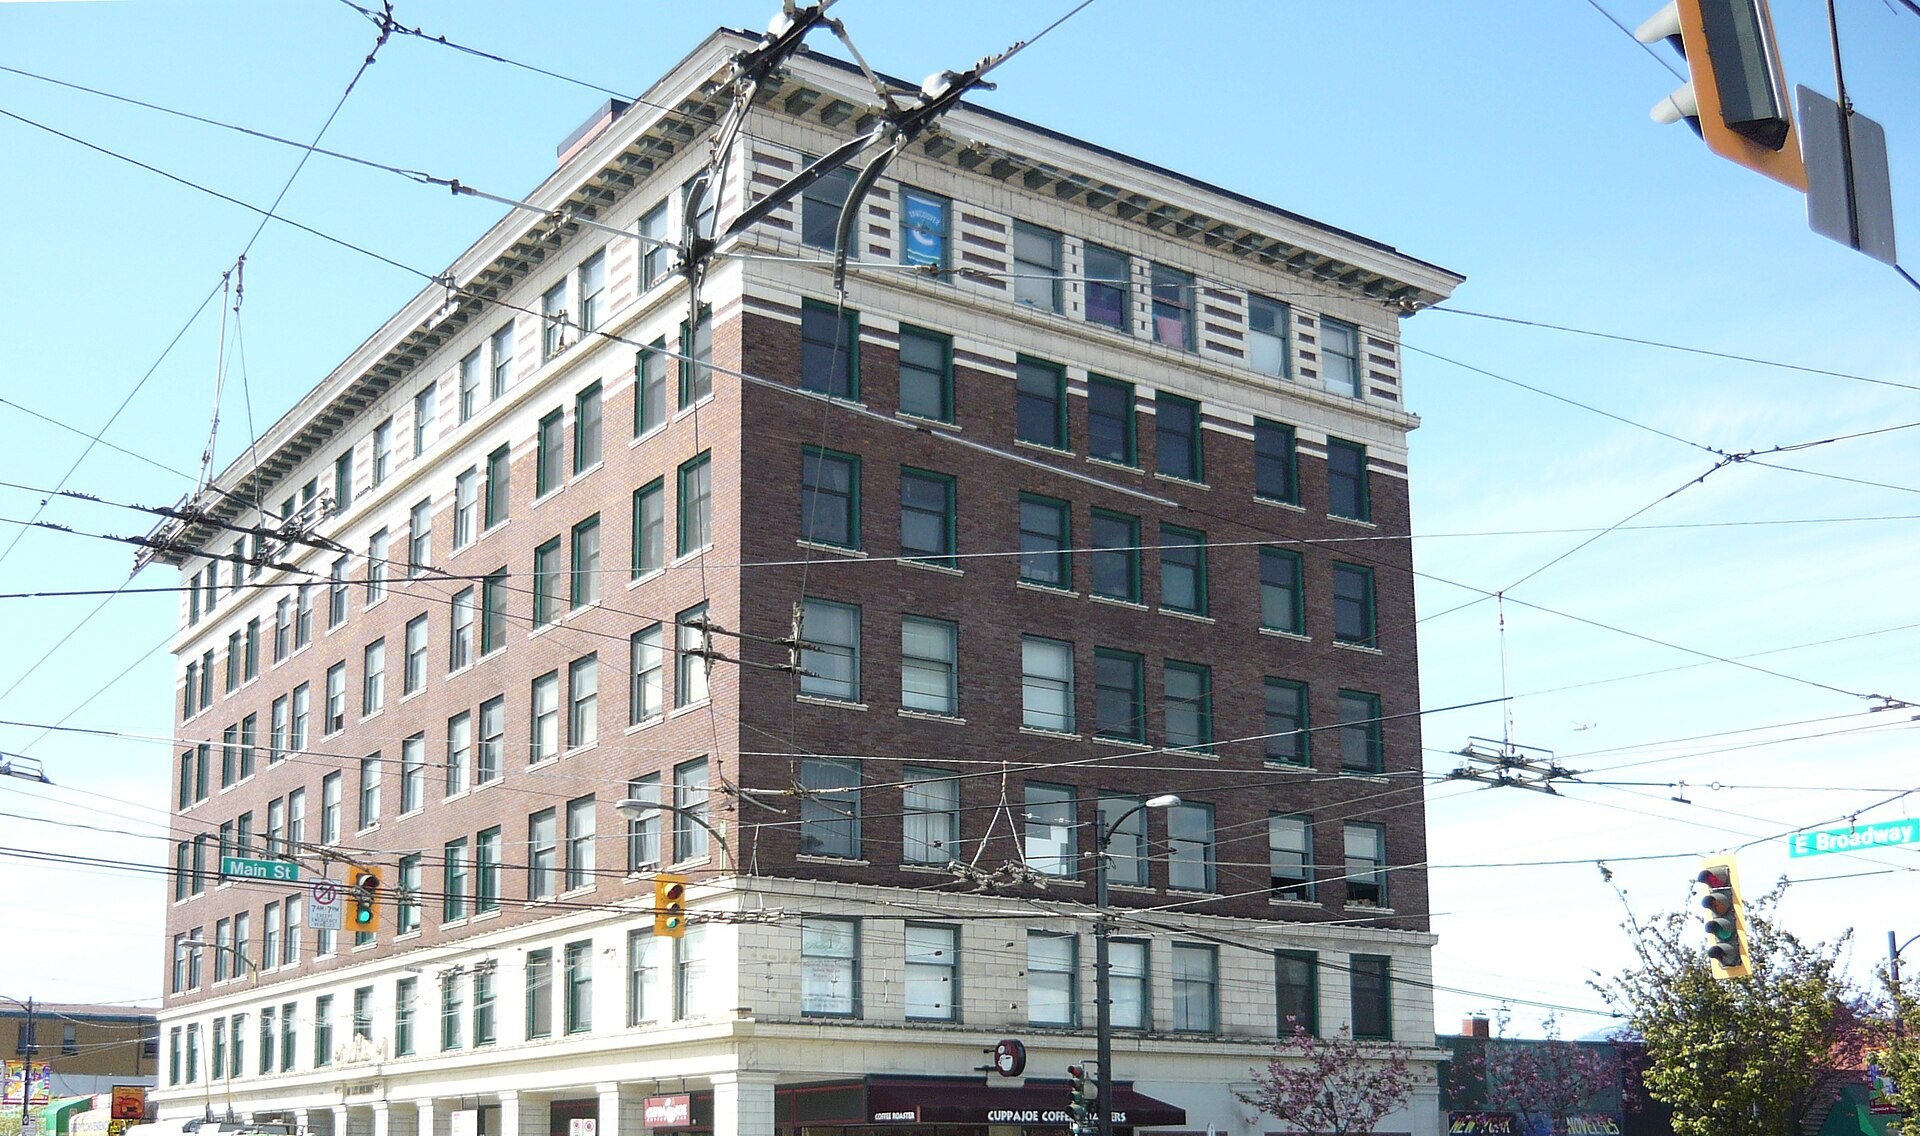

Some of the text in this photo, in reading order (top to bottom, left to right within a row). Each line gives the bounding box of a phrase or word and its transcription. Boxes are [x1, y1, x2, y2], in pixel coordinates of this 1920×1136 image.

[1795, 825, 1913, 854] E Broadway
[230, 861, 291, 880] Main St
[874, 1111, 915, 1120] COFFEE ROASTER
[987, 1110, 1039, 1121] CUPPAJOE
[1041, 1110, 1075, 1122] COFFE
